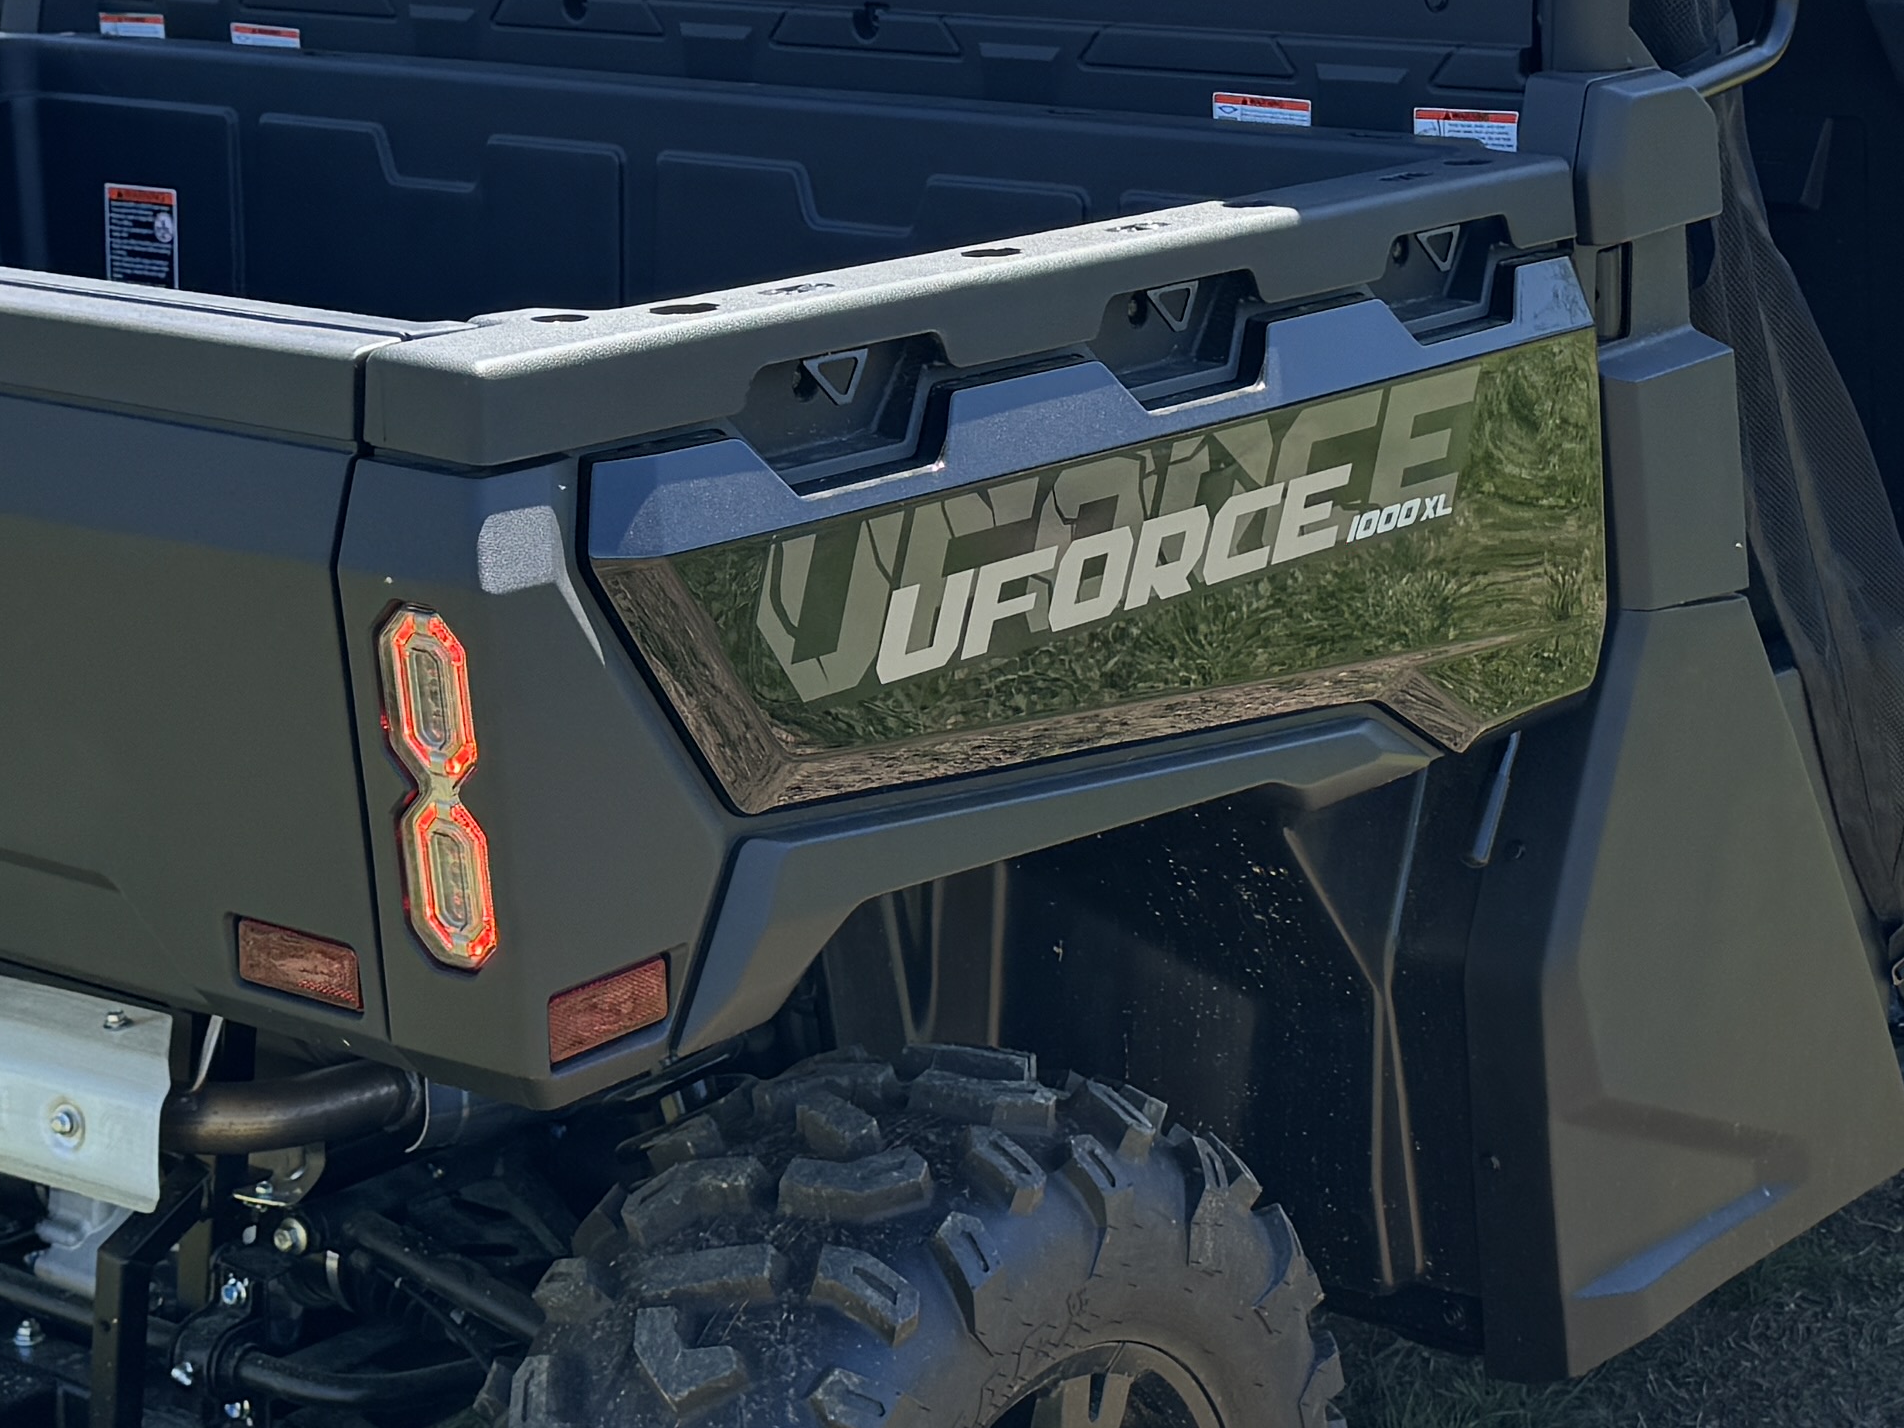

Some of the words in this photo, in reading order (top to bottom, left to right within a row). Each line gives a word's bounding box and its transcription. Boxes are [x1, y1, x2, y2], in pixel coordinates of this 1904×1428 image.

[876, 463, 1353, 685] UFORCE
[1346, 498, 1422, 543] 1000
[1419, 493, 1453, 522] XL
